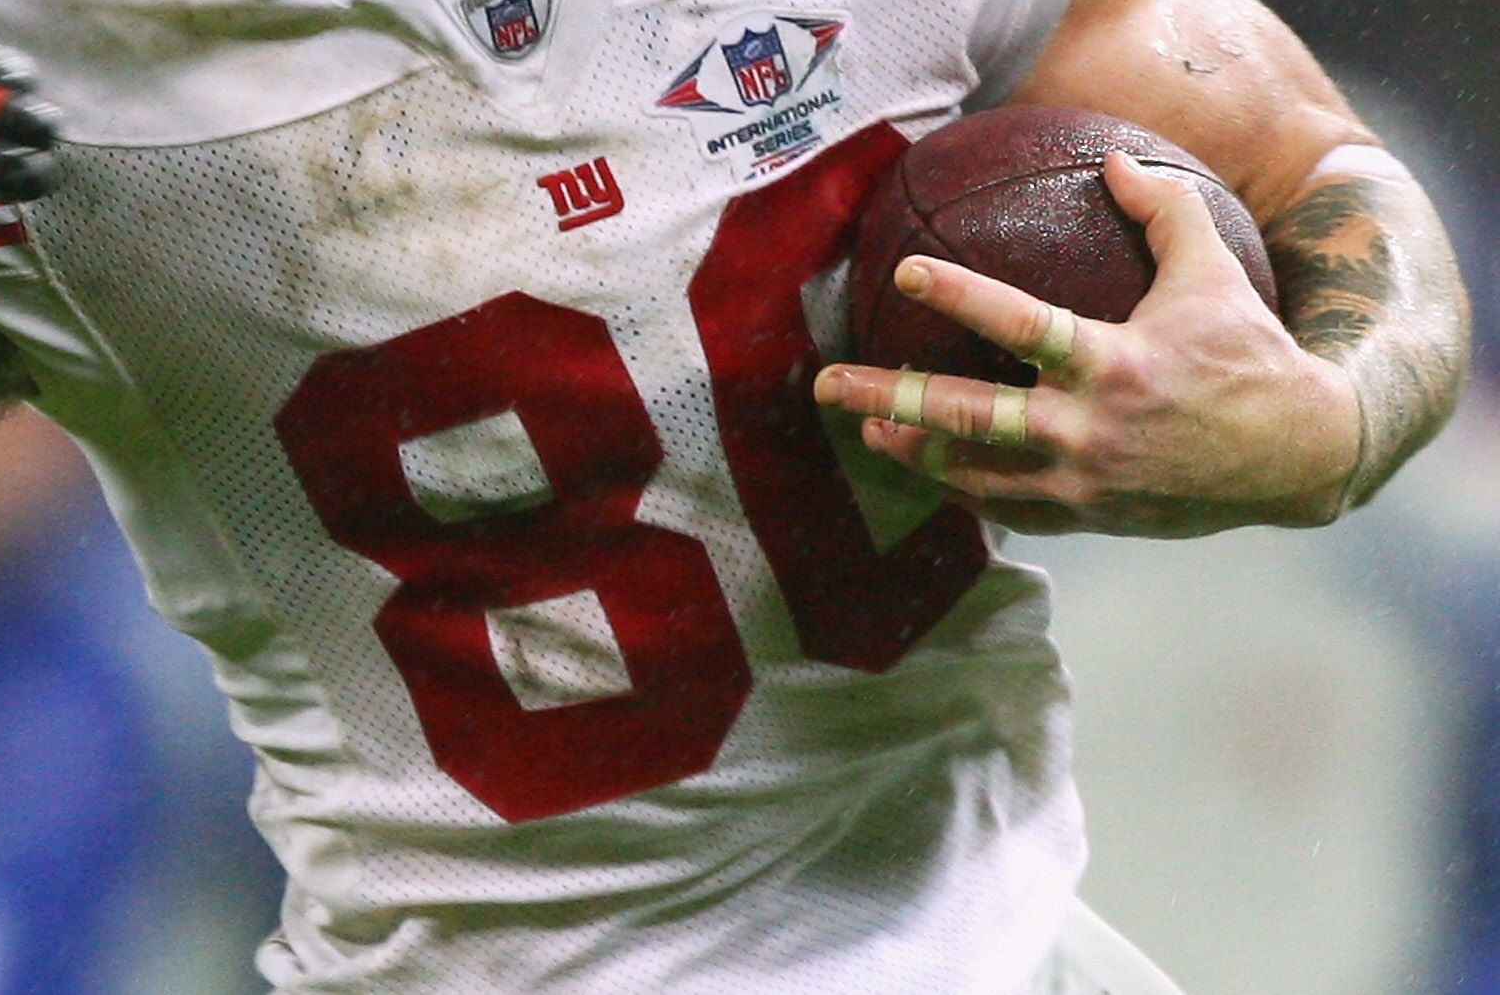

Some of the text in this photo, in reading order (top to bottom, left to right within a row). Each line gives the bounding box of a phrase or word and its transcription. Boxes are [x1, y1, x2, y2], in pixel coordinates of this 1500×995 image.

[493, 16, 539, 49] NFL
[736, 56, 790, 104] NFL
[706, 88, 841, 155] INTERNATIONAL
[751, 119, 814, 159] SERIES
